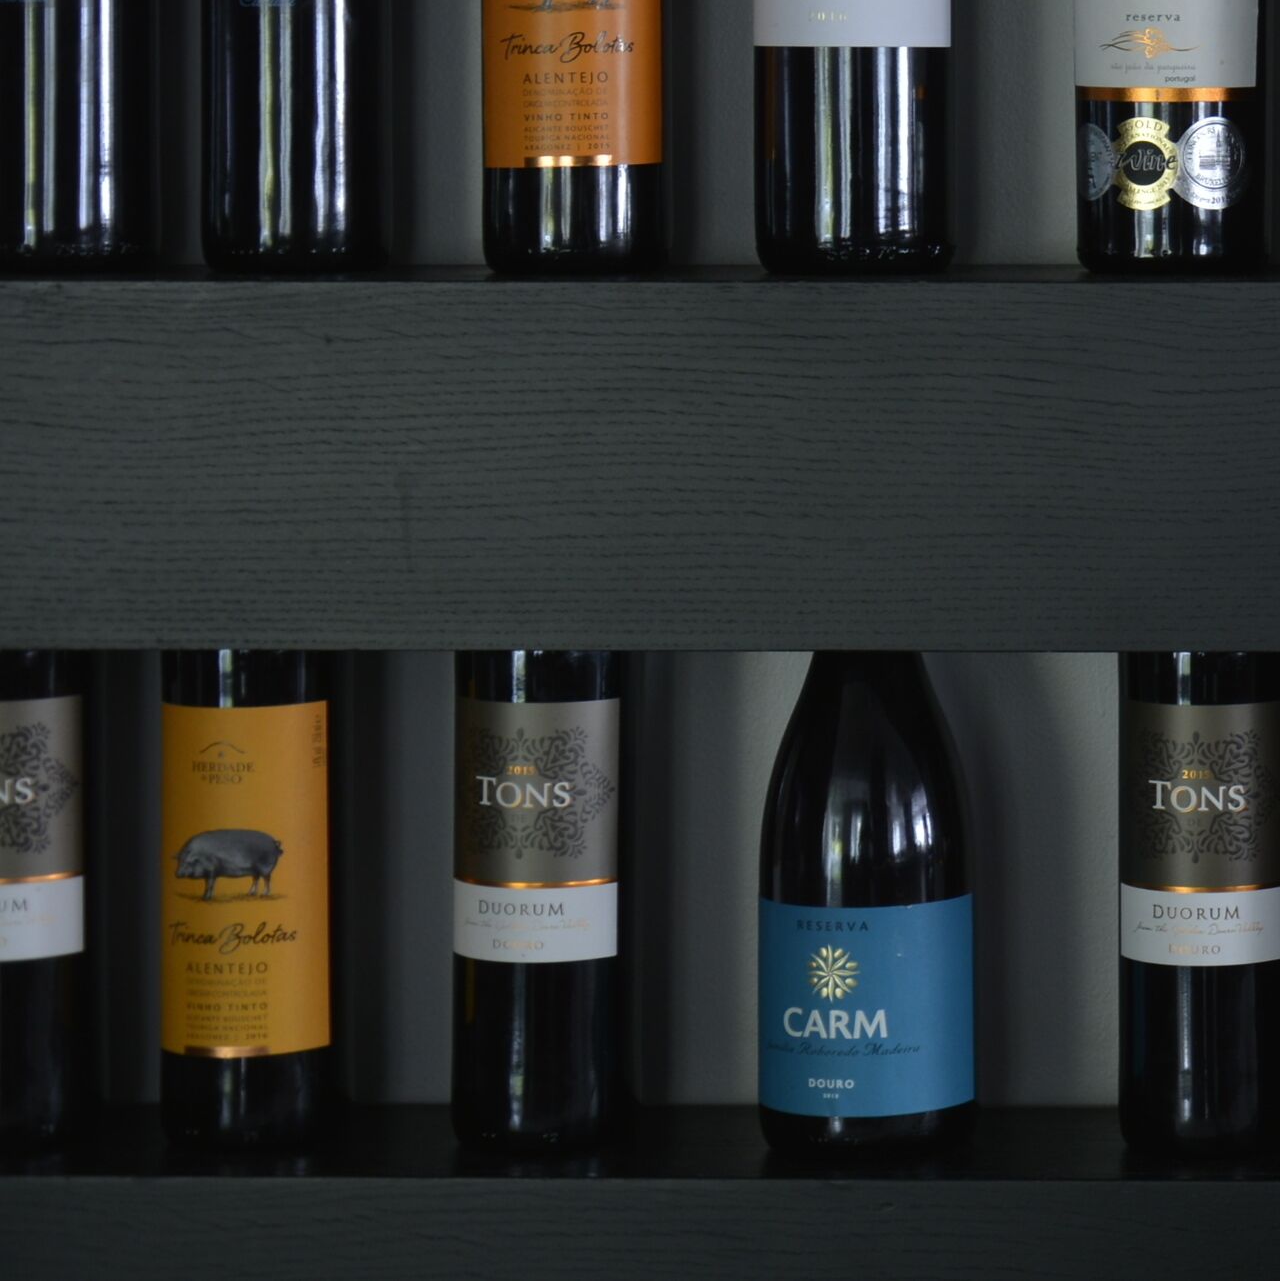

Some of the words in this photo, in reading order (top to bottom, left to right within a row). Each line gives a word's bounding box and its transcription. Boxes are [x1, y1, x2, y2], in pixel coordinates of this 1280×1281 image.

[1125, 13, 1181, 22] reserva
[500, 32, 559, 60] Trinca
[558, 31, 635, 64] Bolotas
[522, 71, 609, 85] ALENTEJO
[1164, 74, 1196, 84] portugal
[523, 112, 563, 122] VINHO
[569, 111, 609, 121] TINTO
[192, 760, 255, 773] HERDADE
[476, 775, 574, 809] TONS
[1148, 779, 1249, 813] TONS
[478, 899, 565, 917] DUORUM
[1152, 903, 1241, 921] DUORUM
[796, 919, 869, 932] RESERVA
[218, 921, 300, 955] Bolotas
[186, 961, 269, 976] ALENTEJO
[783, 1006, 889, 1040] CARM
[808, 1078, 855, 1090] DOURO
